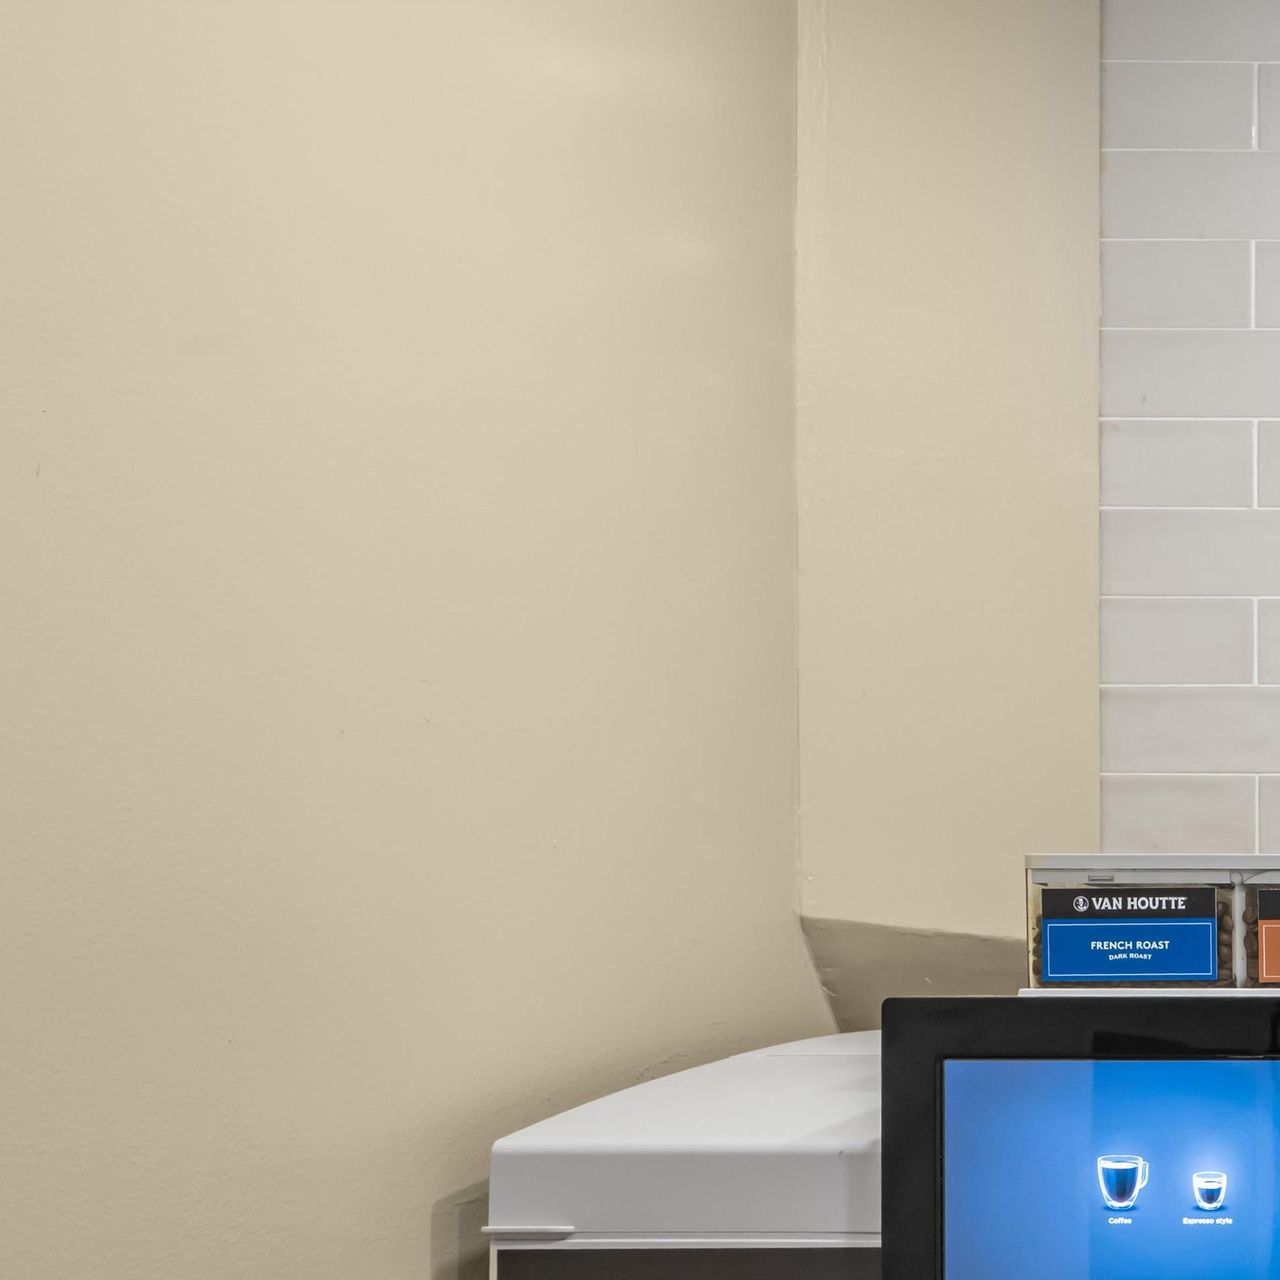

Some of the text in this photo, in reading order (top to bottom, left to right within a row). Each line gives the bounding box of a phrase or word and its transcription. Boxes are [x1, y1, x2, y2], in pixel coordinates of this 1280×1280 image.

[1091, 896, 1187, 910] VAN HOUTTE
[1090, 940, 1170, 950] FRENCH ROAST
[1108, 952, 1152, 961] DARK ROAST
[1107, 1216, 1133, 1225] Coffee
[1182, 1217, 1234, 1226] Espresso style
